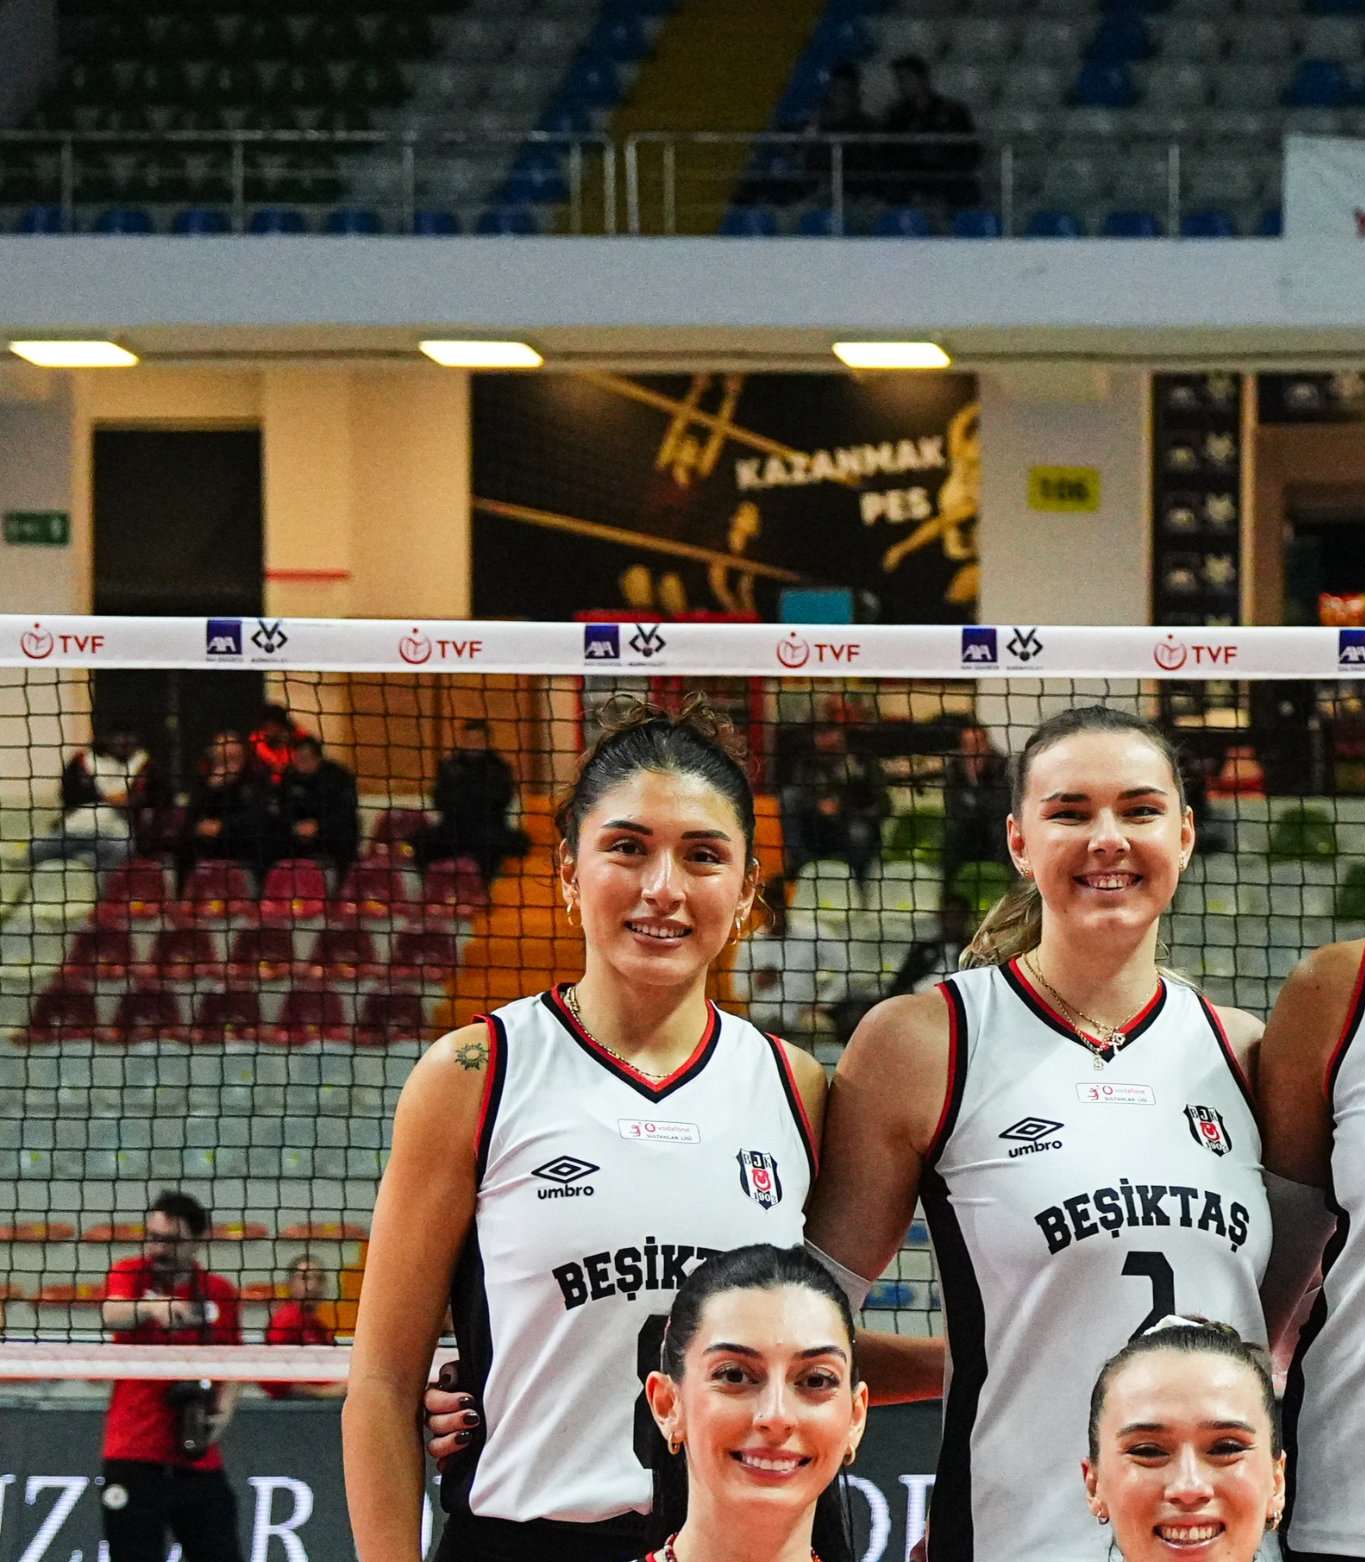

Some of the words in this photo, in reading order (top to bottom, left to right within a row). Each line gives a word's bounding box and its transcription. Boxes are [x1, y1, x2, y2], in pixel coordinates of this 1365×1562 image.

[735, 436, 946, 489] KAZANMAK
[61, 634, 104, 653] TVF
[438, 640, 481, 658] TVF
[816, 643, 860, 662] TVF
[1193, 645, 1238, 664] TVF
[1008, 1140, 1063, 1158] umbro
[537, 1184, 594, 1199] umbro
[1034, 1178, 1250, 1256] BEŞİKTAŞ
[552, 1236, 726, 1311] BEŞİK
